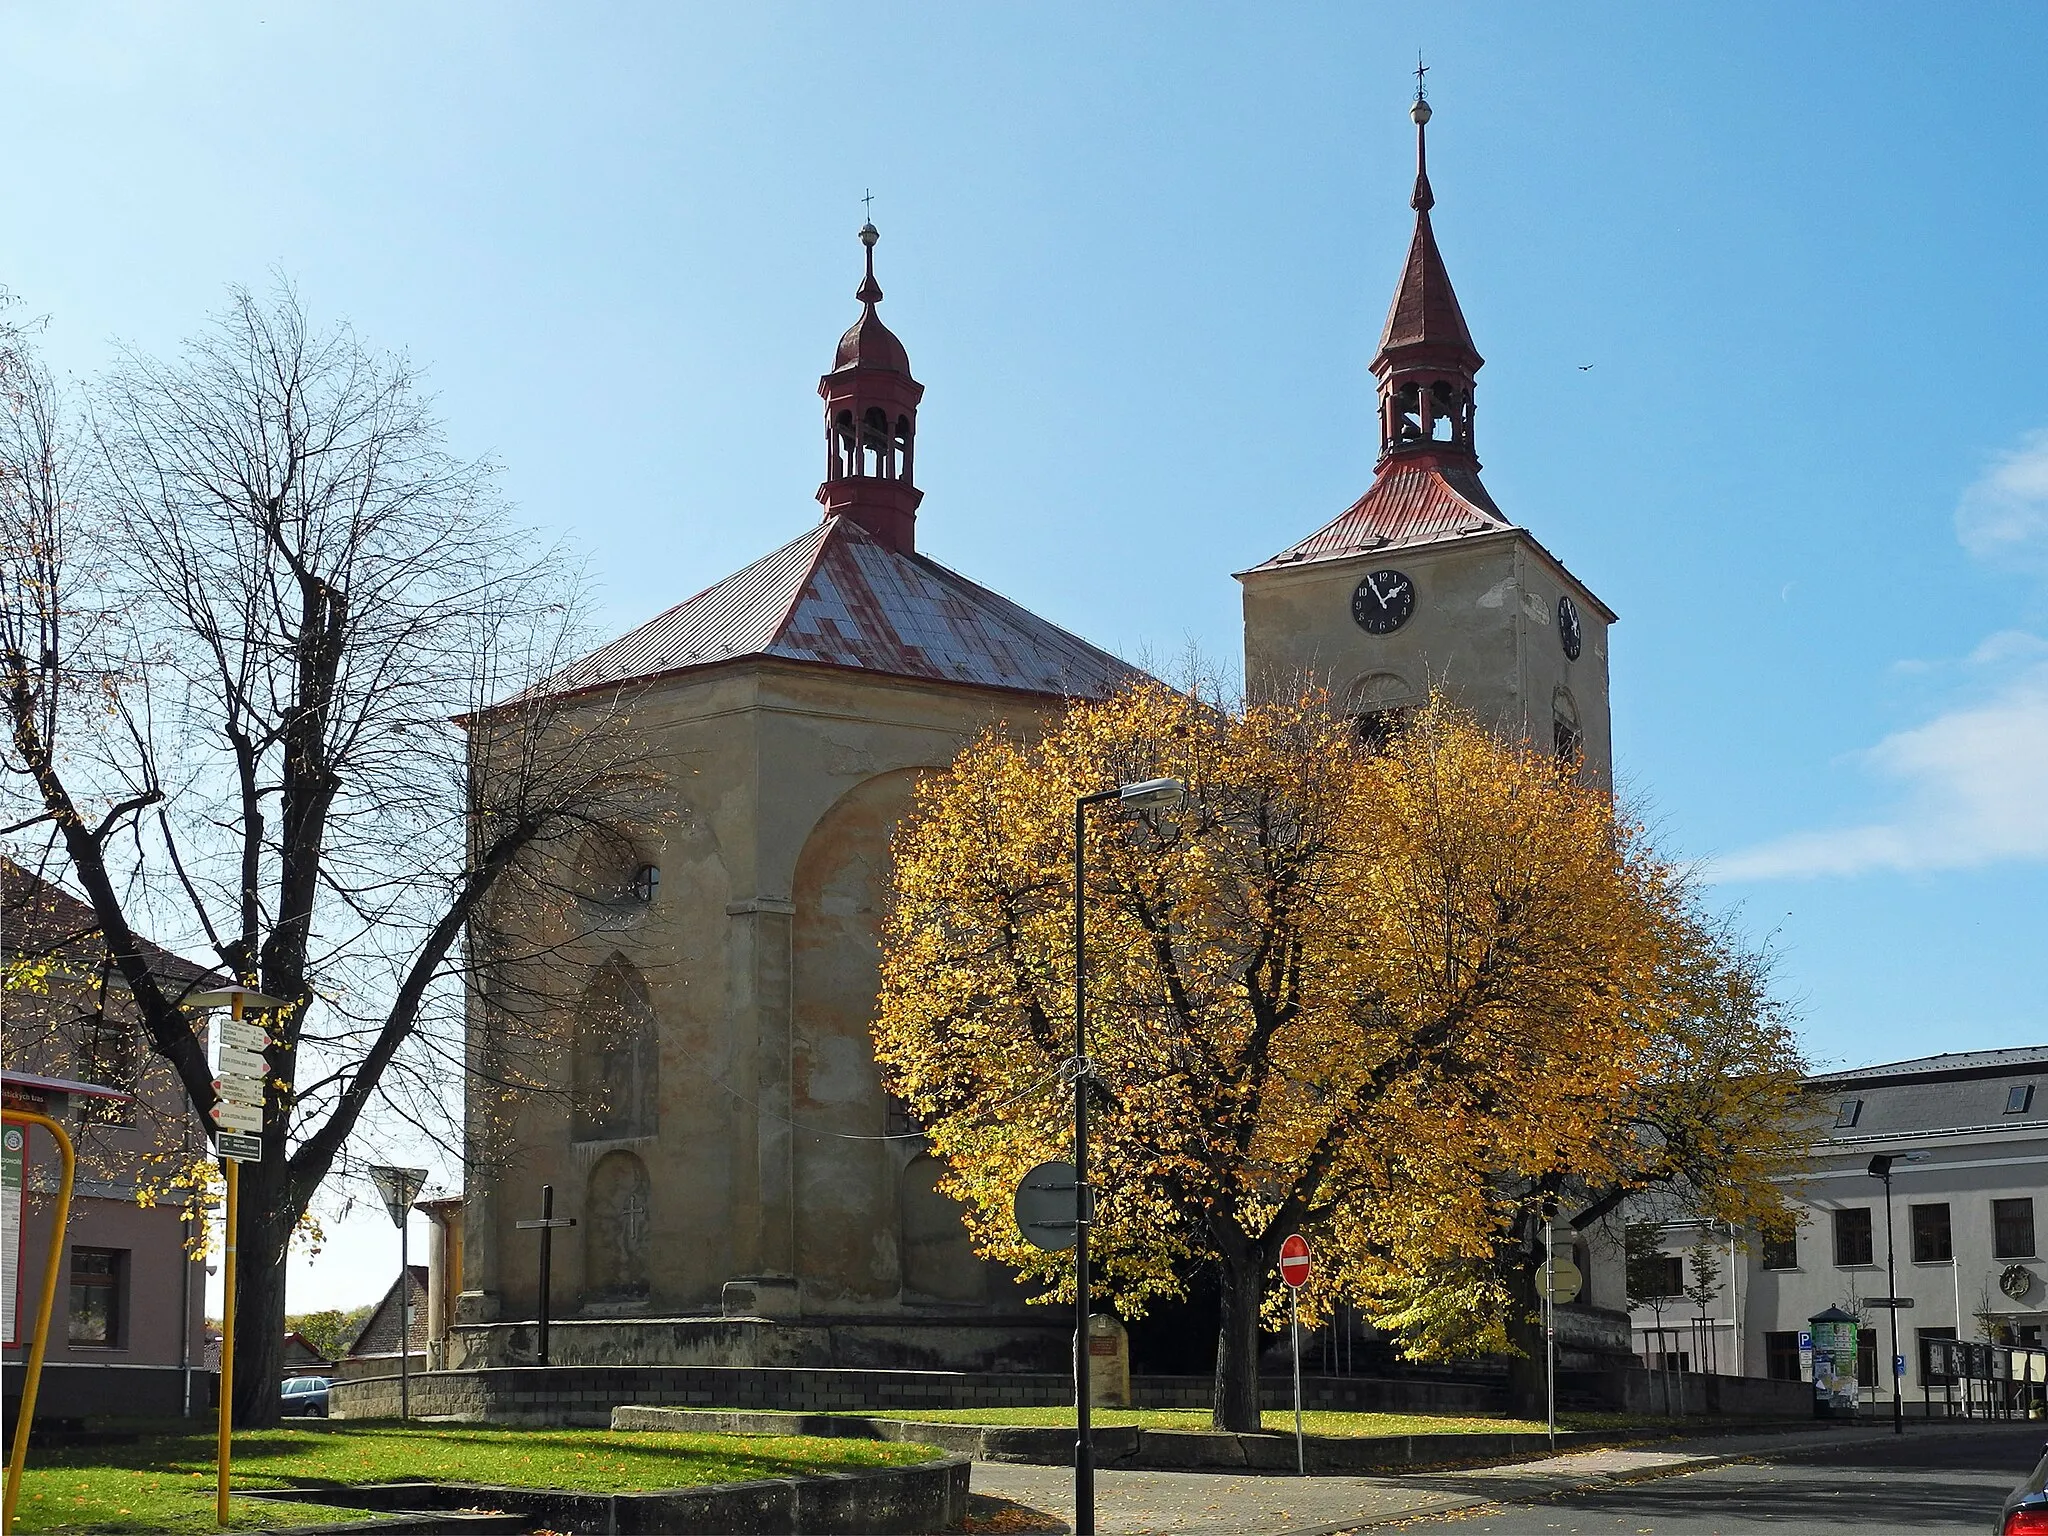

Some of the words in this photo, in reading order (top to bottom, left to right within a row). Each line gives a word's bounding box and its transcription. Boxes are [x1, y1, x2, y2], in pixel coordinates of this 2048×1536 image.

[1379, 572, 1388, 582] 12
[1401, 582, 1408, 591] 2
[1359, 587, 1367, 597] 10
[1404, 594, 1411, 603] 3
[1356, 601, 1361, 610] 9
[1359, 612, 1364, 621] 8
[1391, 616, 1397, 625] 5
[1368, 620, 1373, 628] 7
[1379, 621, 1385, 629] 6
[1801, 1334, 1810, 1346] P
